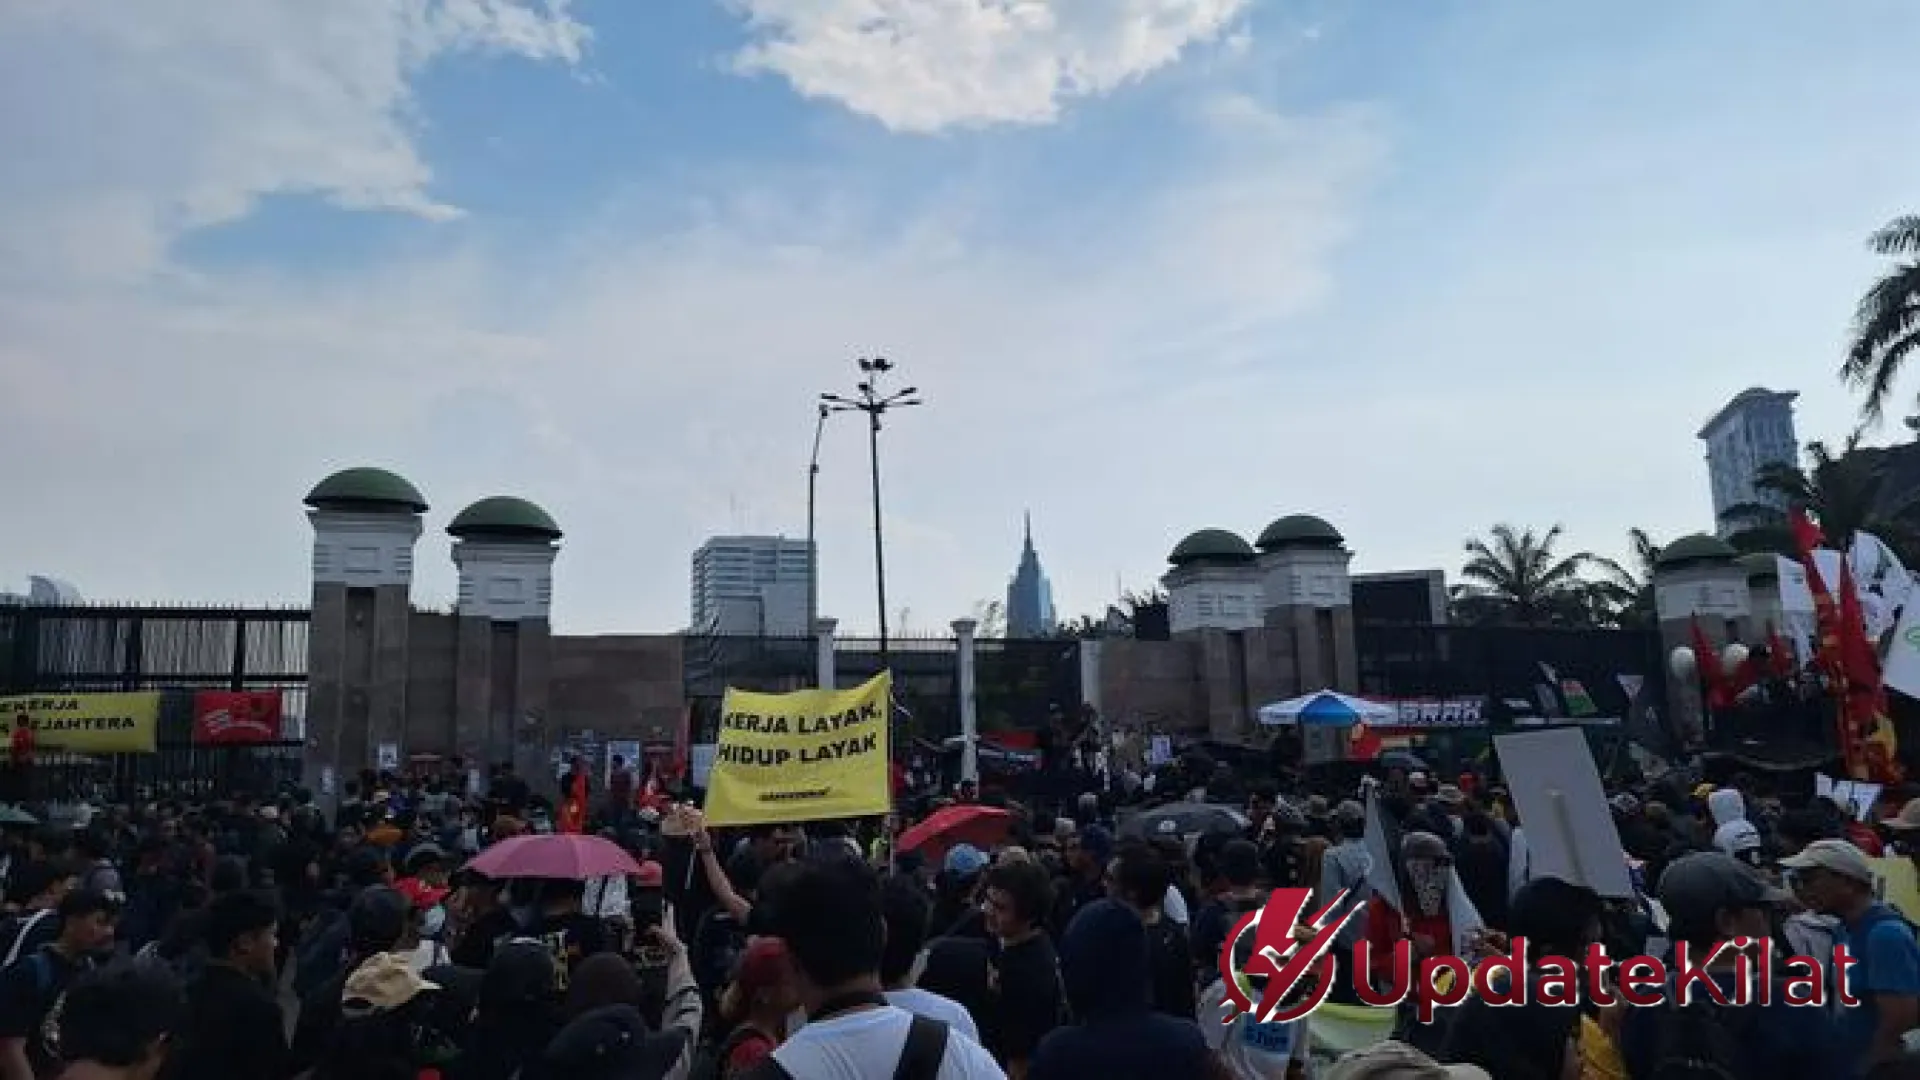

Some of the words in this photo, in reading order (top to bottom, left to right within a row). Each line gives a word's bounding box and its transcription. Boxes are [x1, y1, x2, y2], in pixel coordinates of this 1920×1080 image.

[30, 716, 135, 731] EJAHTERA
[717, 744, 790, 765] HIDUP
[801, 732, 877, 762] LAYAK
